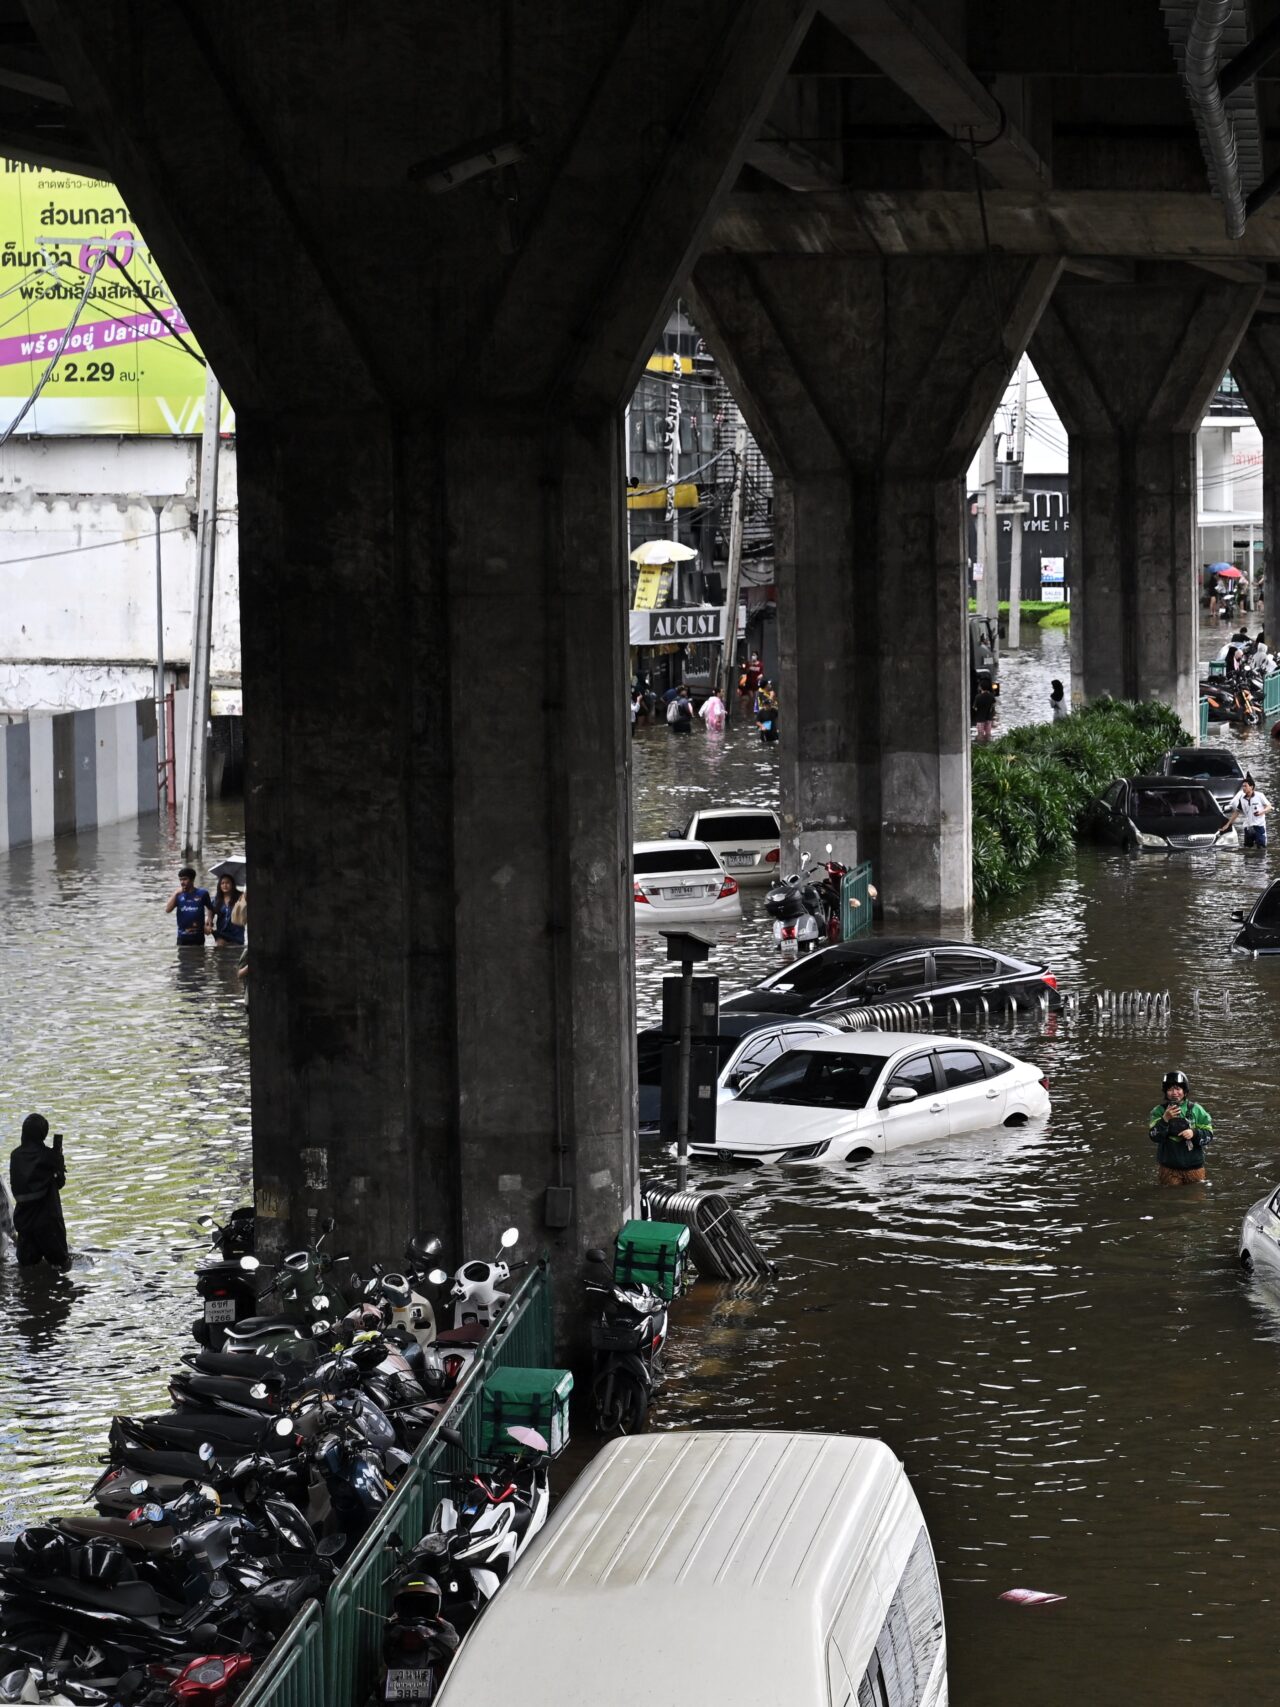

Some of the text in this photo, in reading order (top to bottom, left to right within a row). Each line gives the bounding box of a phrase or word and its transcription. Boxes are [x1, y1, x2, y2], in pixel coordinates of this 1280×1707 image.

[79, 230, 135, 275] 60
[64, 362, 115, 382] 2.29
[1033, 491, 1070, 518] m
[1003, 520, 1050, 532] RYME
[653, 614, 717, 637] AUGUST
